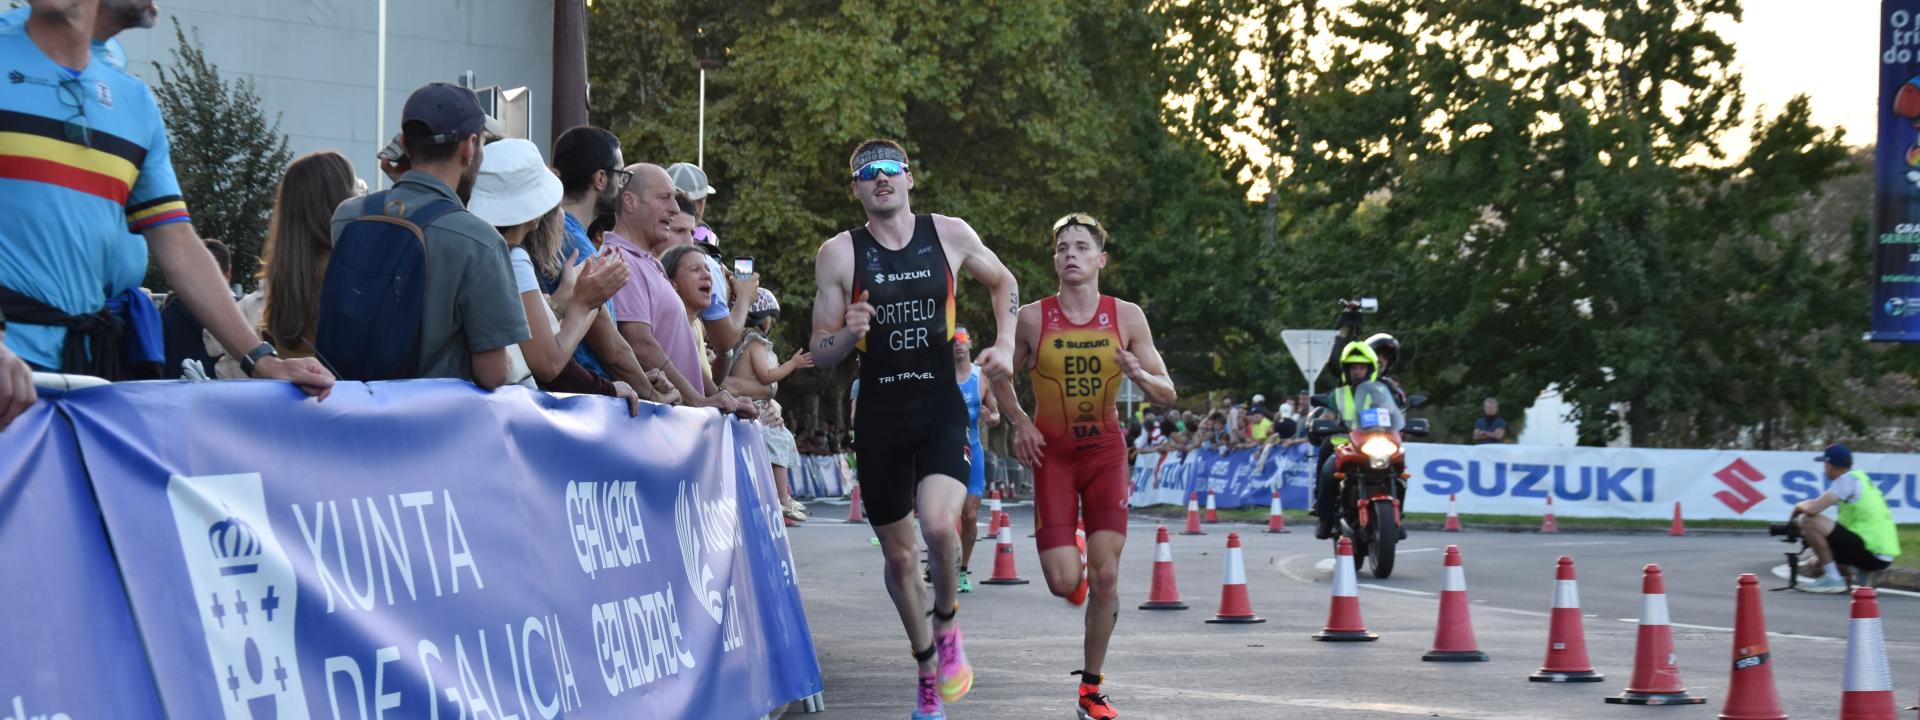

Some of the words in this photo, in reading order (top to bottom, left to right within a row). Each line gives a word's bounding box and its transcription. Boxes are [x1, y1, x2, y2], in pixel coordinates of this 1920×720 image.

[1882, 46, 1912, 64] do
[887, 269, 931, 282] SUZUKI
[889, 327, 930, 351] GER
[1066, 339, 1110, 349] SUZUKI
[1064, 355, 1102, 375] EDO
[879, 375, 895, 384] TRI
[897, 371, 935, 381] TRAVEL
[1065, 377, 1102, 397] ESP
[1422, 458, 1655, 503] SUZUKI
[565, 479, 651, 580] GALICIA
[291, 488, 485, 614] XUNTA
[591, 581, 696, 697] CALIDADE
[324, 645, 402, 720] DE
[417, 613, 583, 720] GALICIA
